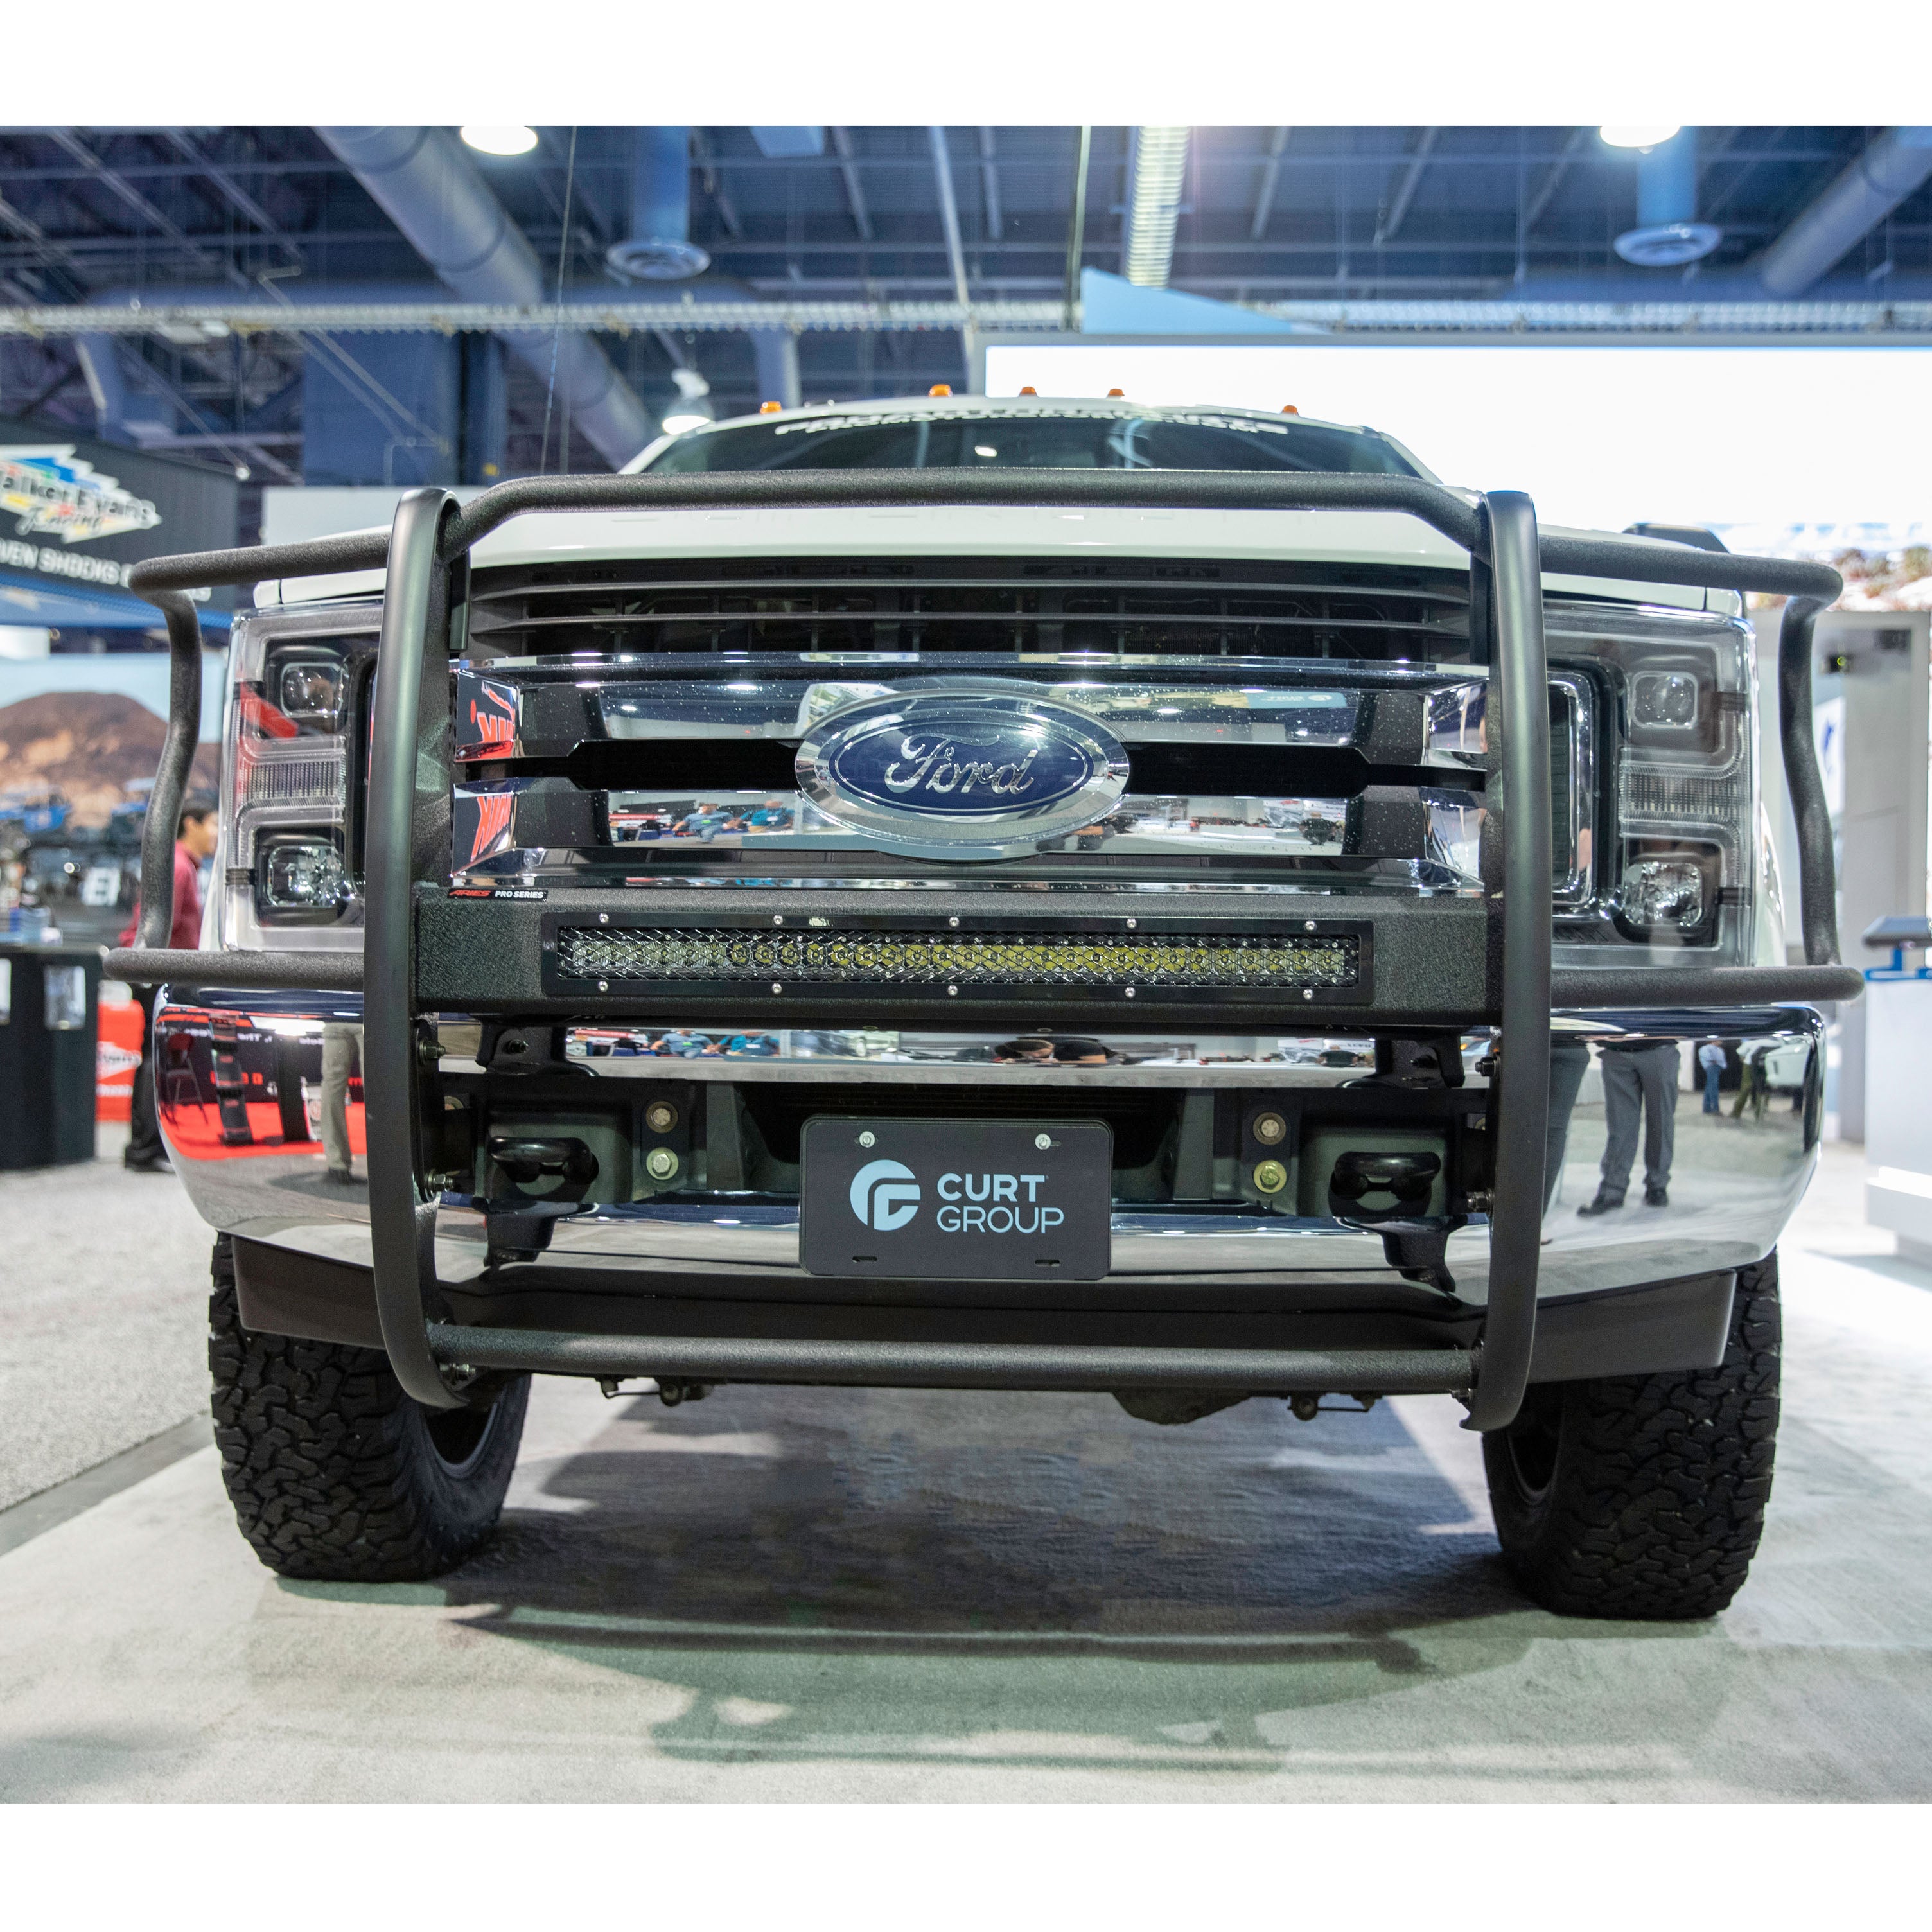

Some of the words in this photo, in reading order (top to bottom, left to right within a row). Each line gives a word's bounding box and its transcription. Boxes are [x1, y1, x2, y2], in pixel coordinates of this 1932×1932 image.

[38, 547, 121, 585] SHOCKS
[884, 733, 1035, 795] Ford
[936, 1172, 1046, 1202] CURT
[936, 1205, 1064, 1234] GROUP
